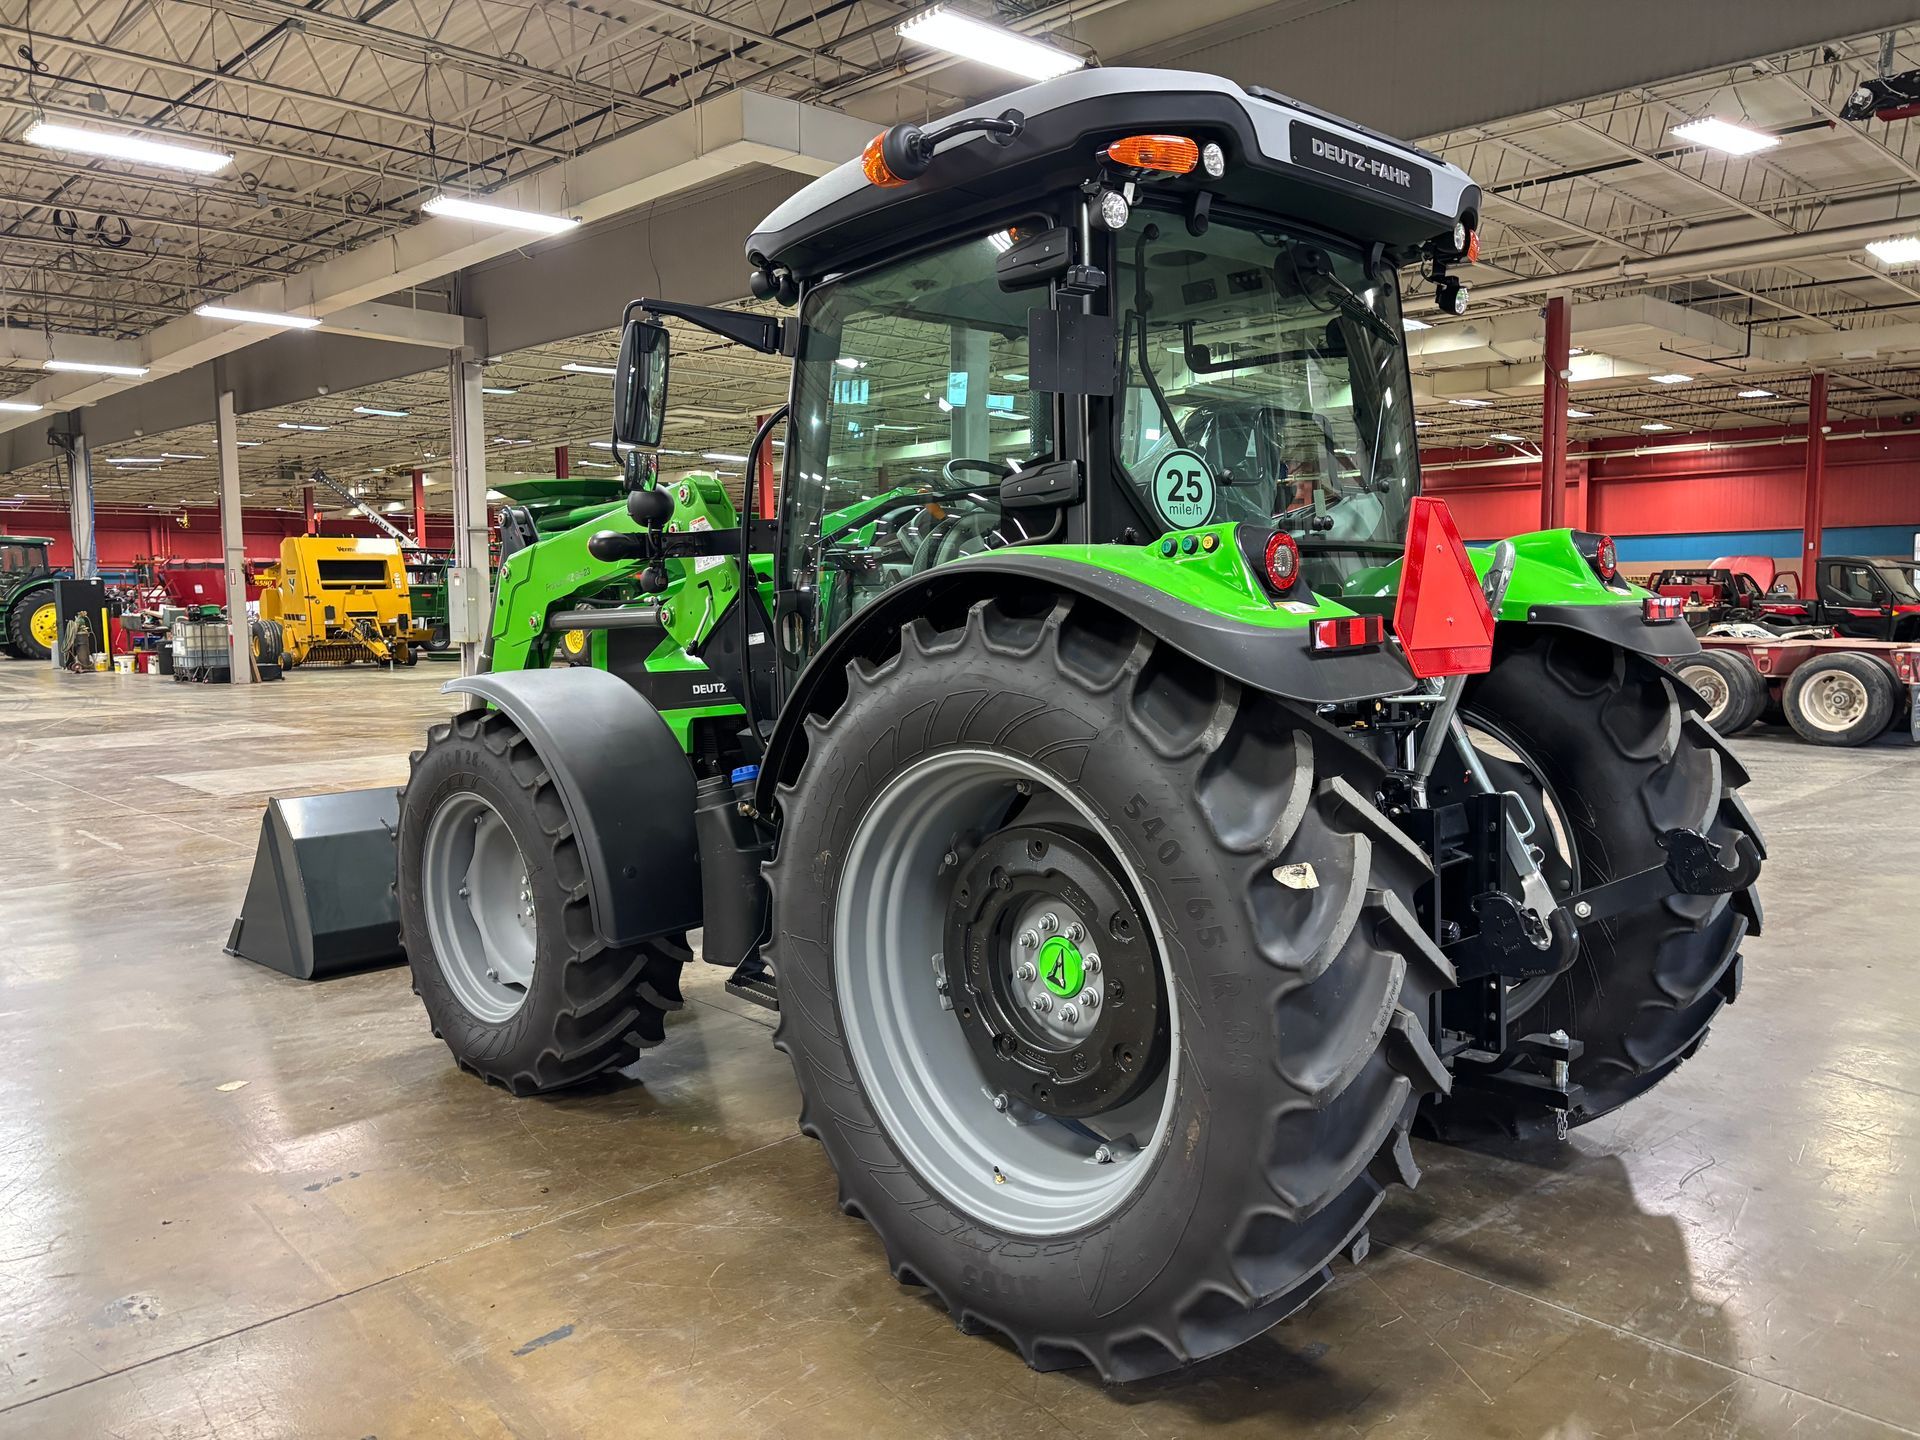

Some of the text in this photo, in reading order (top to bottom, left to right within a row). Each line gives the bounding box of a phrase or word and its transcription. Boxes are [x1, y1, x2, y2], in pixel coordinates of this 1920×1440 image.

[1312, 137, 1411, 188] DEUTZ-FAHR
[1166, 469, 1203, 503] 25
[1169, 503, 1203, 515] mile/h
[692, 682, 727, 695] DEUTZ
[1123, 791, 1228, 949] 540/65
